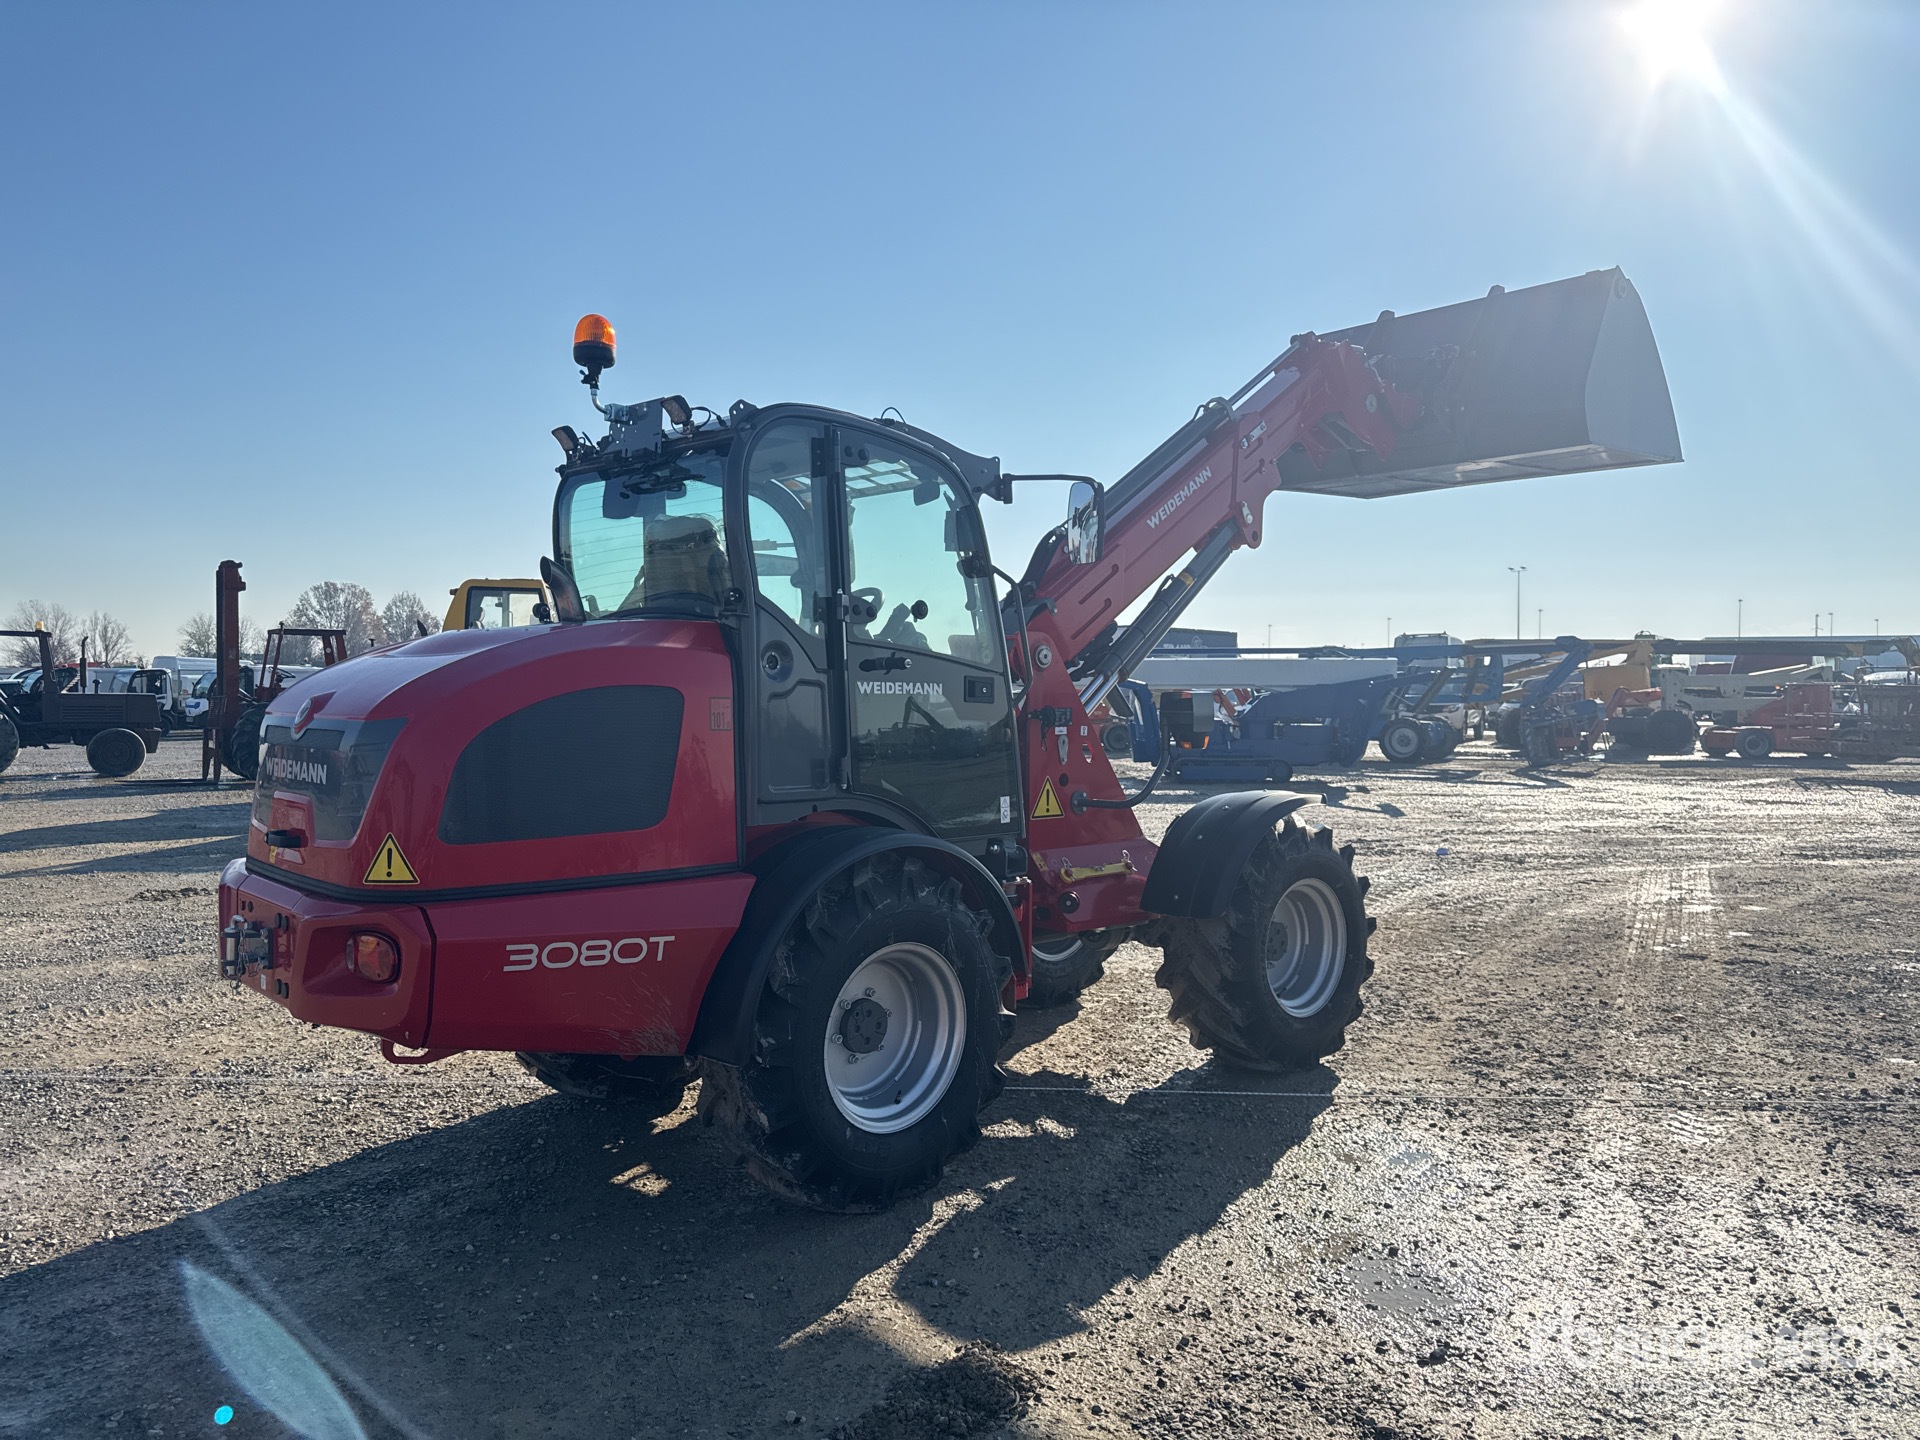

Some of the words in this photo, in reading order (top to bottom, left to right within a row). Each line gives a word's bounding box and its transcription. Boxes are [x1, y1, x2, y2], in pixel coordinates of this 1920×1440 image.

[1146, 466, 1212, 529] WEIDEMANN
[857, 681, 943, 695] WEIDEMANN
[265, 756, 327, 785] WEIDEMANN
[503, 935, 676, 972] 3080T
